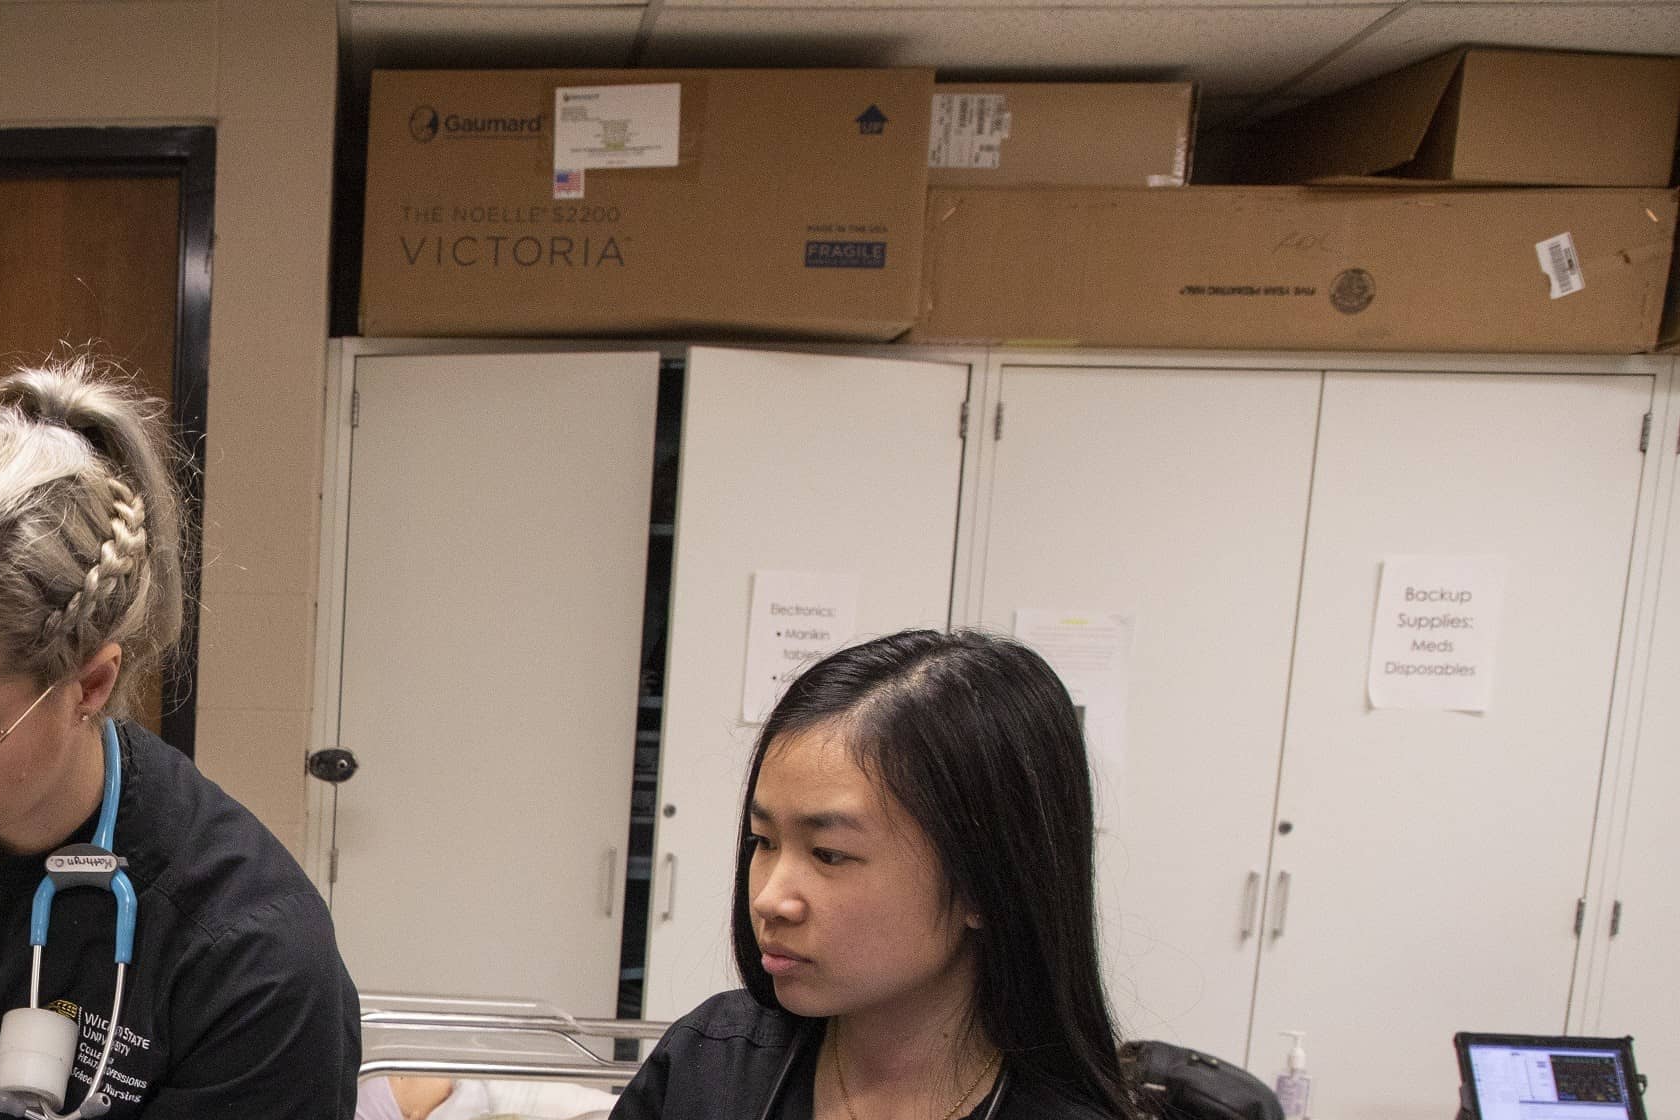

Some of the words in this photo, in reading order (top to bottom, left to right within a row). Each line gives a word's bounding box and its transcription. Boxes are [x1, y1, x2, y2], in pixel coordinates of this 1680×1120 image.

[444, 113, 543, 132] Gaumard
[401, 206, 444, 223] THE
[451, 206, 542, 223] NOELLE
[553, 206, 620, 223] S2200
[400, 236, 625, 267] VICTORIA
[807, 243, 882, 258] FRAGILE
[1405, 586, 1473, 605] Backup
[770, 602, 836, 618] Electronics:
[1397, 612, 1475, 630] Supplies:
[784, 629, 831, 641] Manikin
[1411, 639, 1454, 653] Meds
[1384, 661, 1476, 677] Disposables
[122, 1027, 151, 1050] STATE
